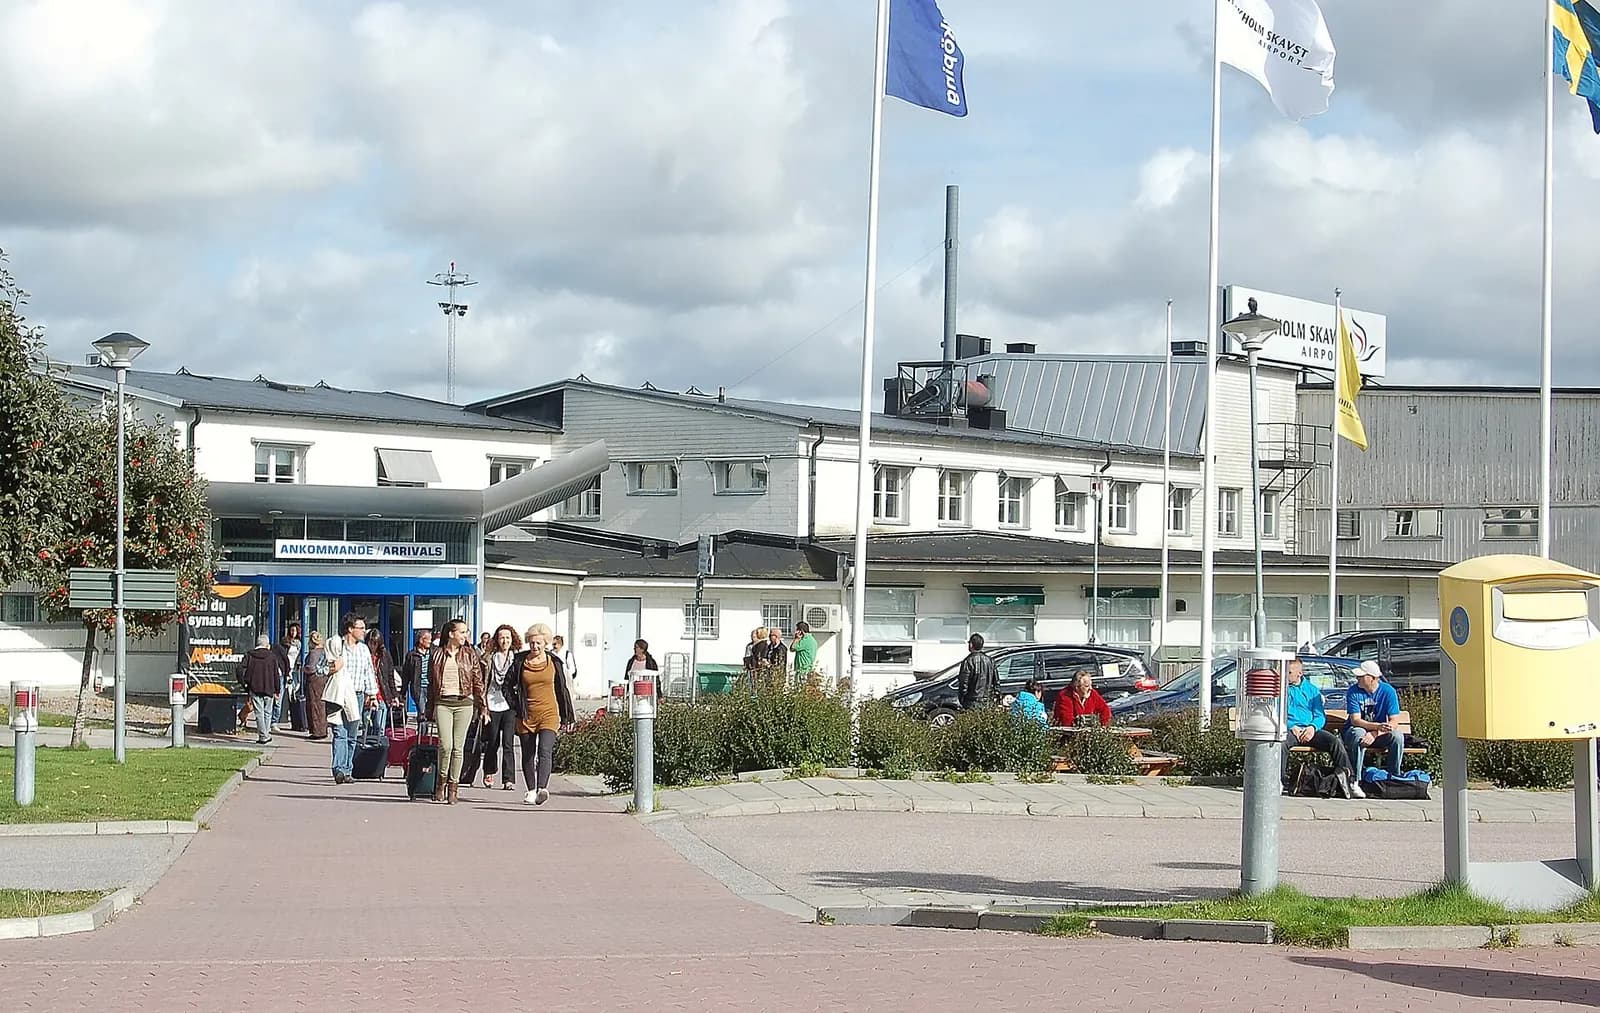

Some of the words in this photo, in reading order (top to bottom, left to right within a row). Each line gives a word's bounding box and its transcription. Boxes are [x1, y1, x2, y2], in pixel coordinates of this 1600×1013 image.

[1258, 39, 1302, 66] AIRPORT
[280, 544, 374, 556] ANKOMMANDE
[382, 546, 443, 557] ARRIVALS
[210, 599, 227, 612] du
[188, 615, 224, 628] synas
[226, 614, 254, 627] här?
